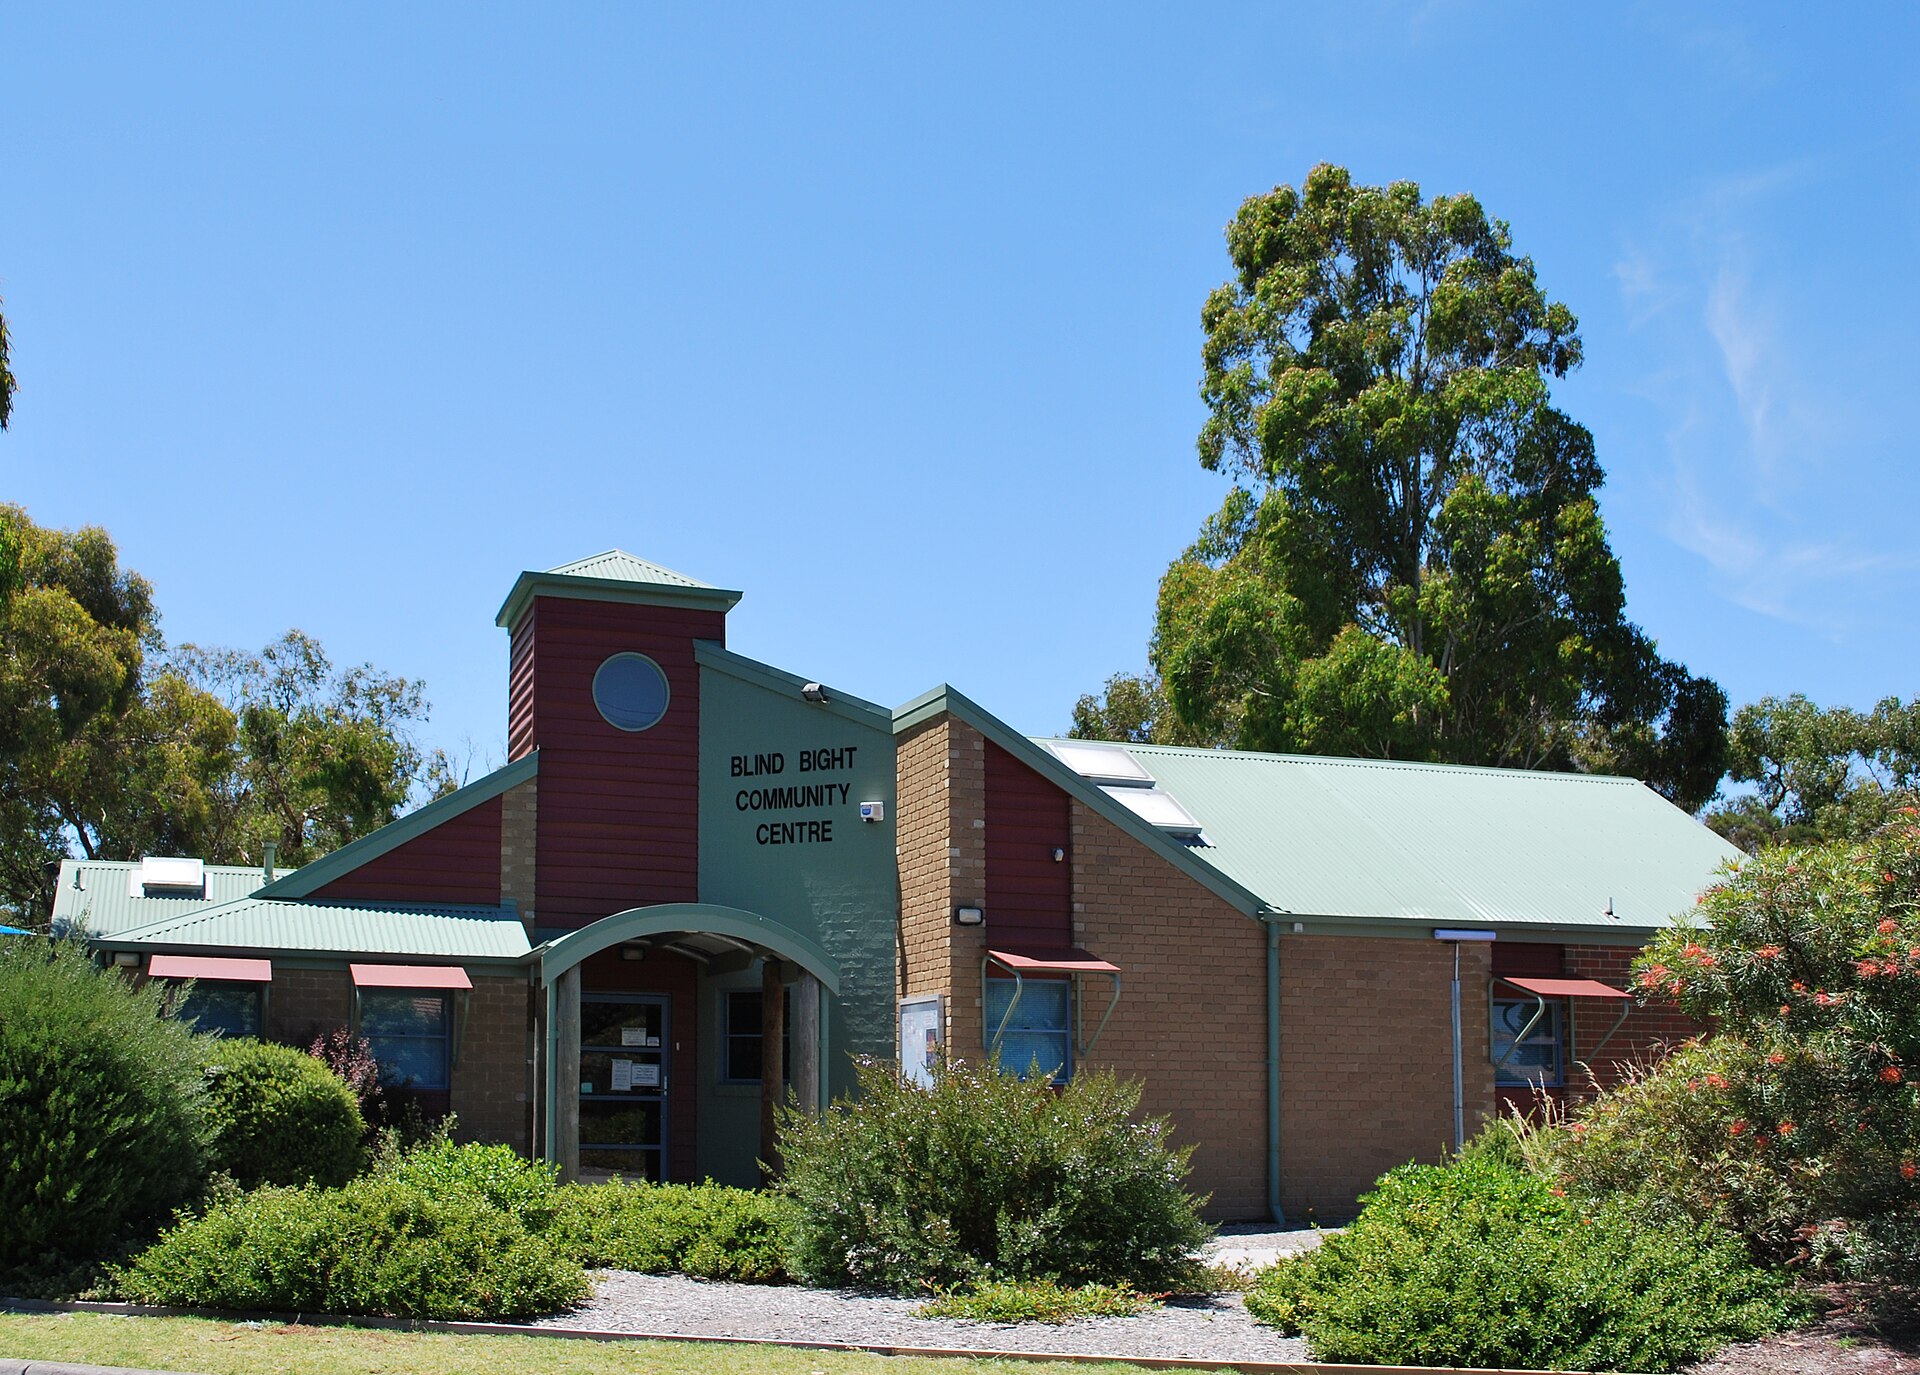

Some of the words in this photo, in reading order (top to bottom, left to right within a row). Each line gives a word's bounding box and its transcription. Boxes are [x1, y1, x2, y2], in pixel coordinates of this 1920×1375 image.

[730, 753, 784, 777] BLIND
[799, 746, 857, 772] BIGHT
[735, 783, 850, 811] COMMUNITY
[756, 821, 832, 845] CENTRE
